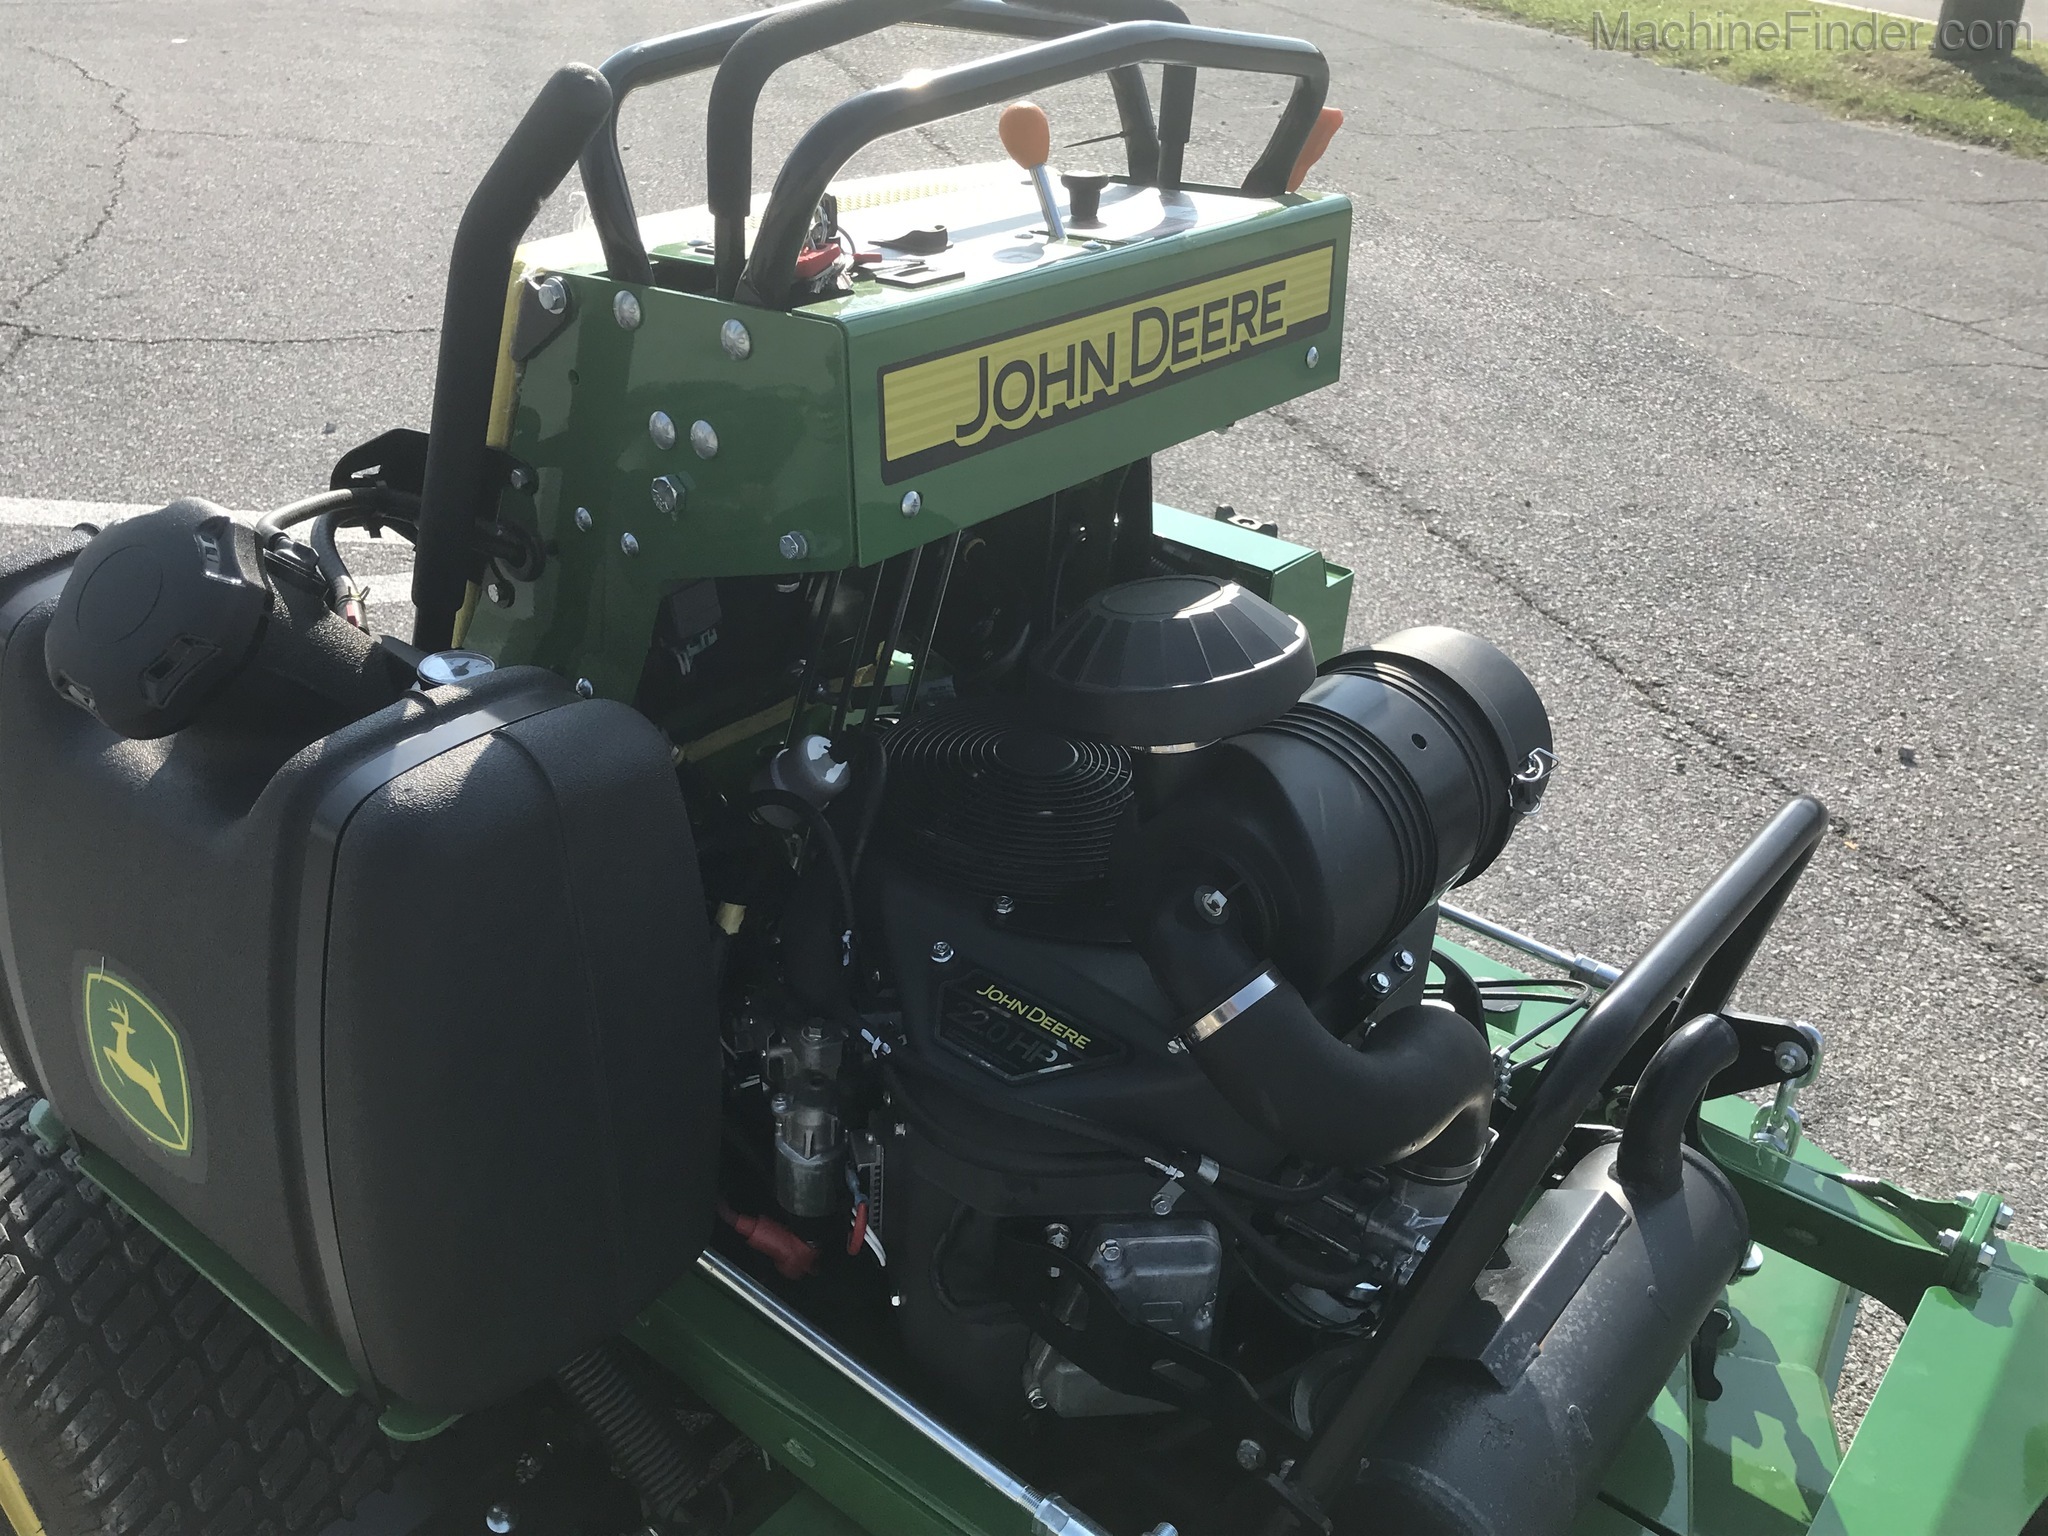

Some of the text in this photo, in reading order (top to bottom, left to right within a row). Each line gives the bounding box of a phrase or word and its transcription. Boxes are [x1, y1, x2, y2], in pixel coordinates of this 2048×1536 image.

[956, 279, 1287, 443] JOHN DEERE
[976, 984, 1091, 1049] JOHN DEERE
[1006, 1032, 1058, 1063] HP
